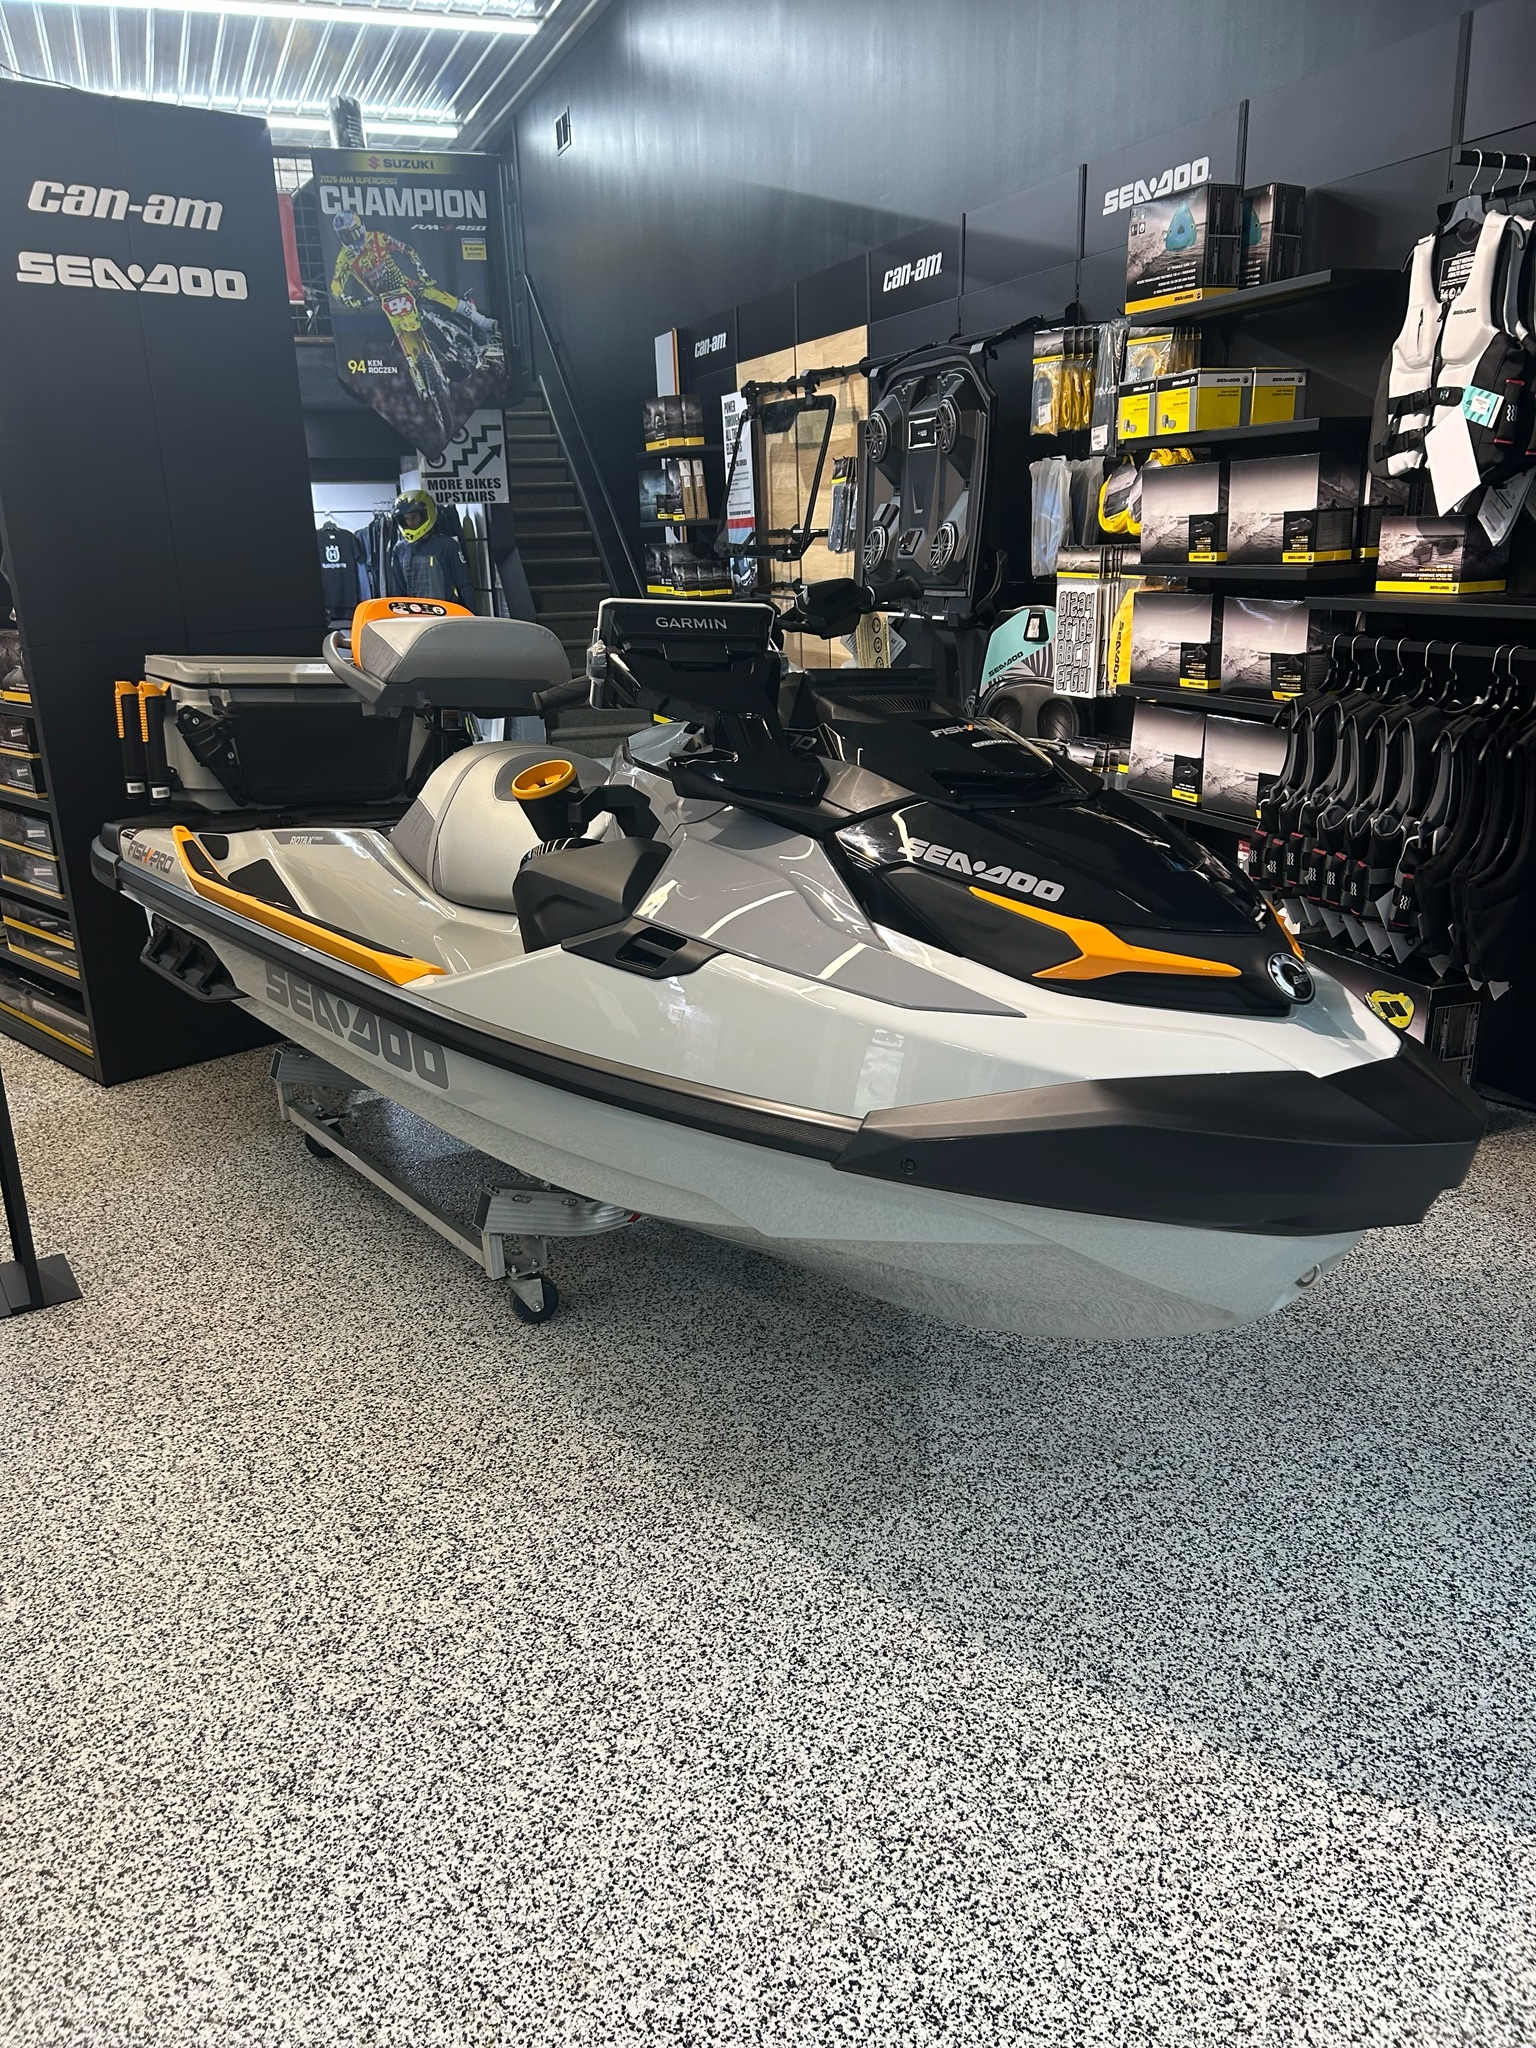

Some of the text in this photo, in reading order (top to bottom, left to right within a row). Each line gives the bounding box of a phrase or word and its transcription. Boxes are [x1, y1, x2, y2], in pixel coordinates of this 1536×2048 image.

[383, 158, 434, 170] SUZUKI
[320, 175, 398, 185] 2026 AMA SUPERCROSS
[28, 180, 223, 231] can-am
[319, 185, 487, 219] CHAMPION
[882, 252, 943, 293] can-am
[389, 297, 411, 315] 94
[694, 332, 727, 358] can-am
[348, 359, 383, 374] 94 KEN
[368, 366, 398, 374] ROCZEN
[427, 477, 501, 491] MORE BIKES
[435, 490, 496, 504] UPSTAIRS
[655, 616, 728, 630] GARMIN
[289, 835, 314, 846] ROTAX
[1293, 974, 1309, 984] BRP
